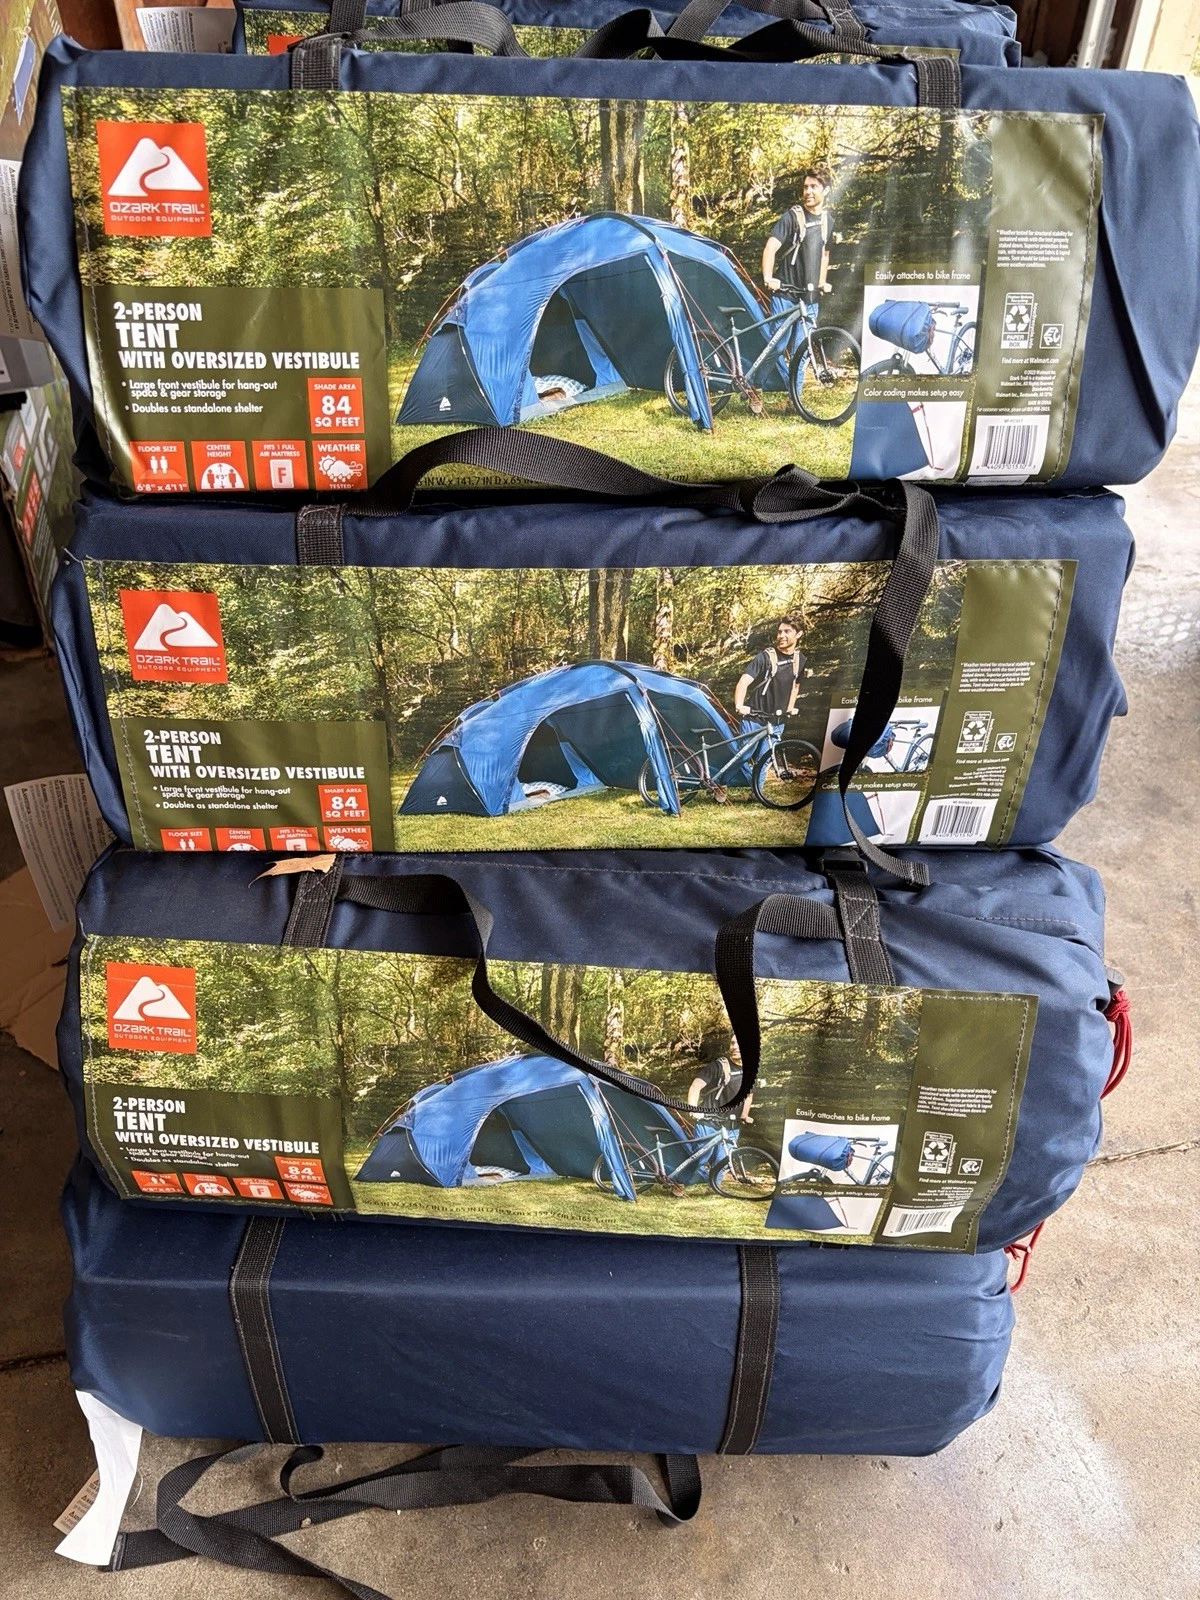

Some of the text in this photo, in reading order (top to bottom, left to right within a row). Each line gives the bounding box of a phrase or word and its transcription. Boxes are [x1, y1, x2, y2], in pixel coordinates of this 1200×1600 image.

[109, 201, 160, 214] OZARK
[875, 271, 971, 282] Easily attaches to bike frame
[113, 301, 203, 322] 2-PERSON
[115, 322, 180, 349] TENT
[119, 351, 360, 369] WITH OVERSIZED VESTIBULE
[129, 378, 277, 393] Large front vestibule for hang-out
[313, 383, 357, 391] SHADE AREA
[131, 388, 227, 400] space & gear storage
[863, 388, 965, 398] Color coding makes setup easy
[131, 402, 263, 413] Doubles as standalone shelter
[321, 395, 352, 416] 84
[314, 416, 361, 428] SQ FEET
[317, 444, 361, 454] WEATHER
[277, 467, 287, 484] F
[136, 654, 180, 665] OZARK
[898, 695, 913, 704] bike
[913, 695, 933, 704] frame
[143, 729, 222, 745] 2-PERSON
[145, 744, 202, 764] TENT
[149, 765, 365, 781] WITH OVERSIZED VESTIBULE
[160, 785, 291, 797] Large front vestibule for hang-out
[863, 781, 883, 789] makes
[902, 781, 918, 789] easy
[195, 792, 213, 800] gear
[215, 792, 245, 801] storage
[162, 801, 195, 810] Doubles
[208, 801, 250, 810] standalone
[252, 802, 279, 811] shelter
[331, 796, 358, 810] 84
[325, 810, 366, 818] SQ FEET
[113, 1023, 155, 1034] OZARK
[151, 1035, 191, 1043] EQUIPMENT
[112, 1096, 186, 1114] 2-PERSON
[795, 1108, 890, 1121] Easily attaches to bike frame
[113, 1111, 167, 1132] TENT
[114, 1131, 320, 1155] WITH OVERSIZED VESTIBULE
[288, 1166, 314, 1176] 84
[800, 1188, 822, 1196] coding
